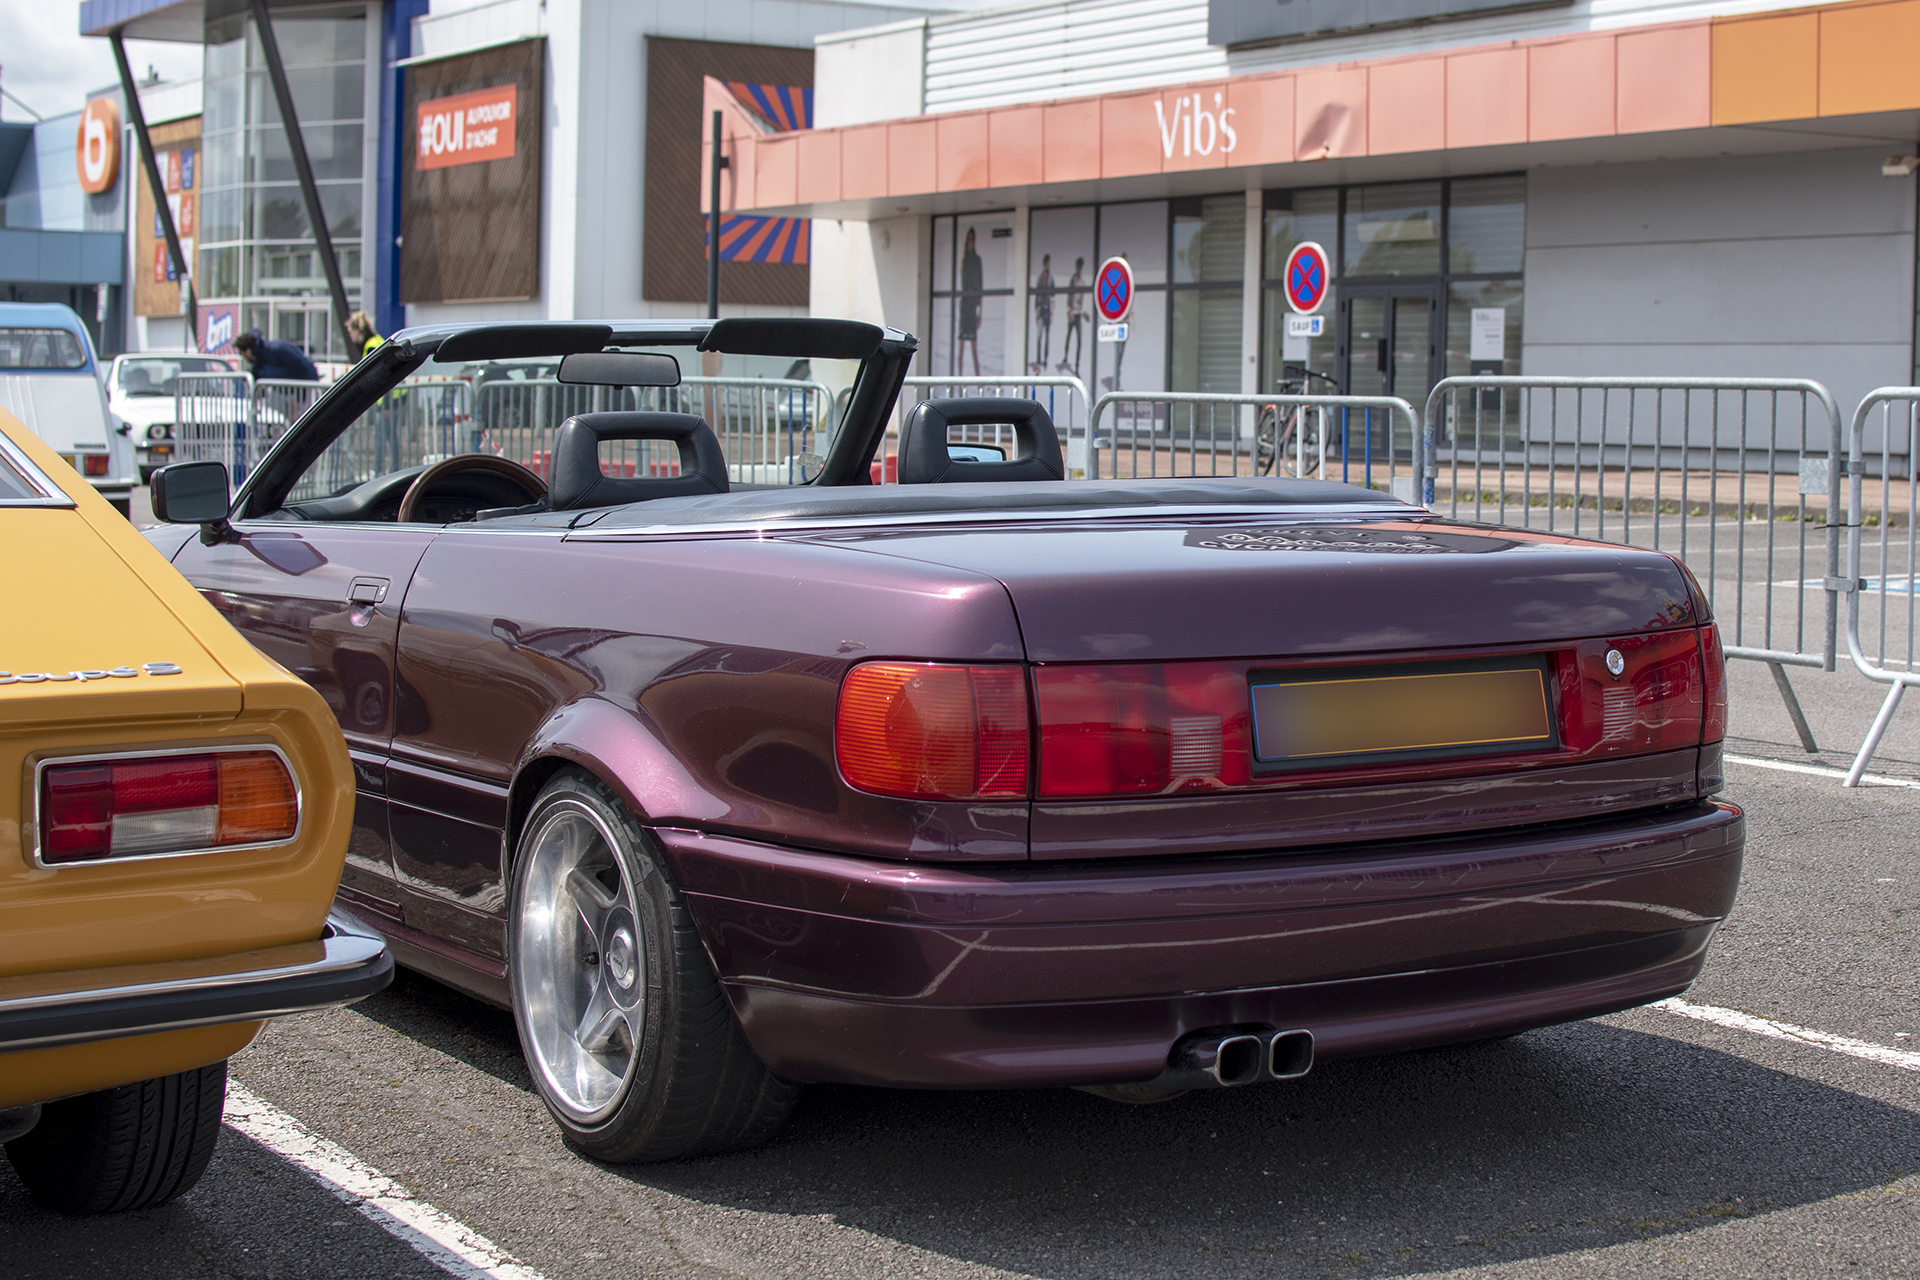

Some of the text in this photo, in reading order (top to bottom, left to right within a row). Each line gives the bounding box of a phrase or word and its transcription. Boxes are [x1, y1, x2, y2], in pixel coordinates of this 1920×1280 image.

[420, 110, 464, 156] #OUI
[1153, 92, 1237, 159] Vib's
[1291, 321, 1310, 331] SAUF
